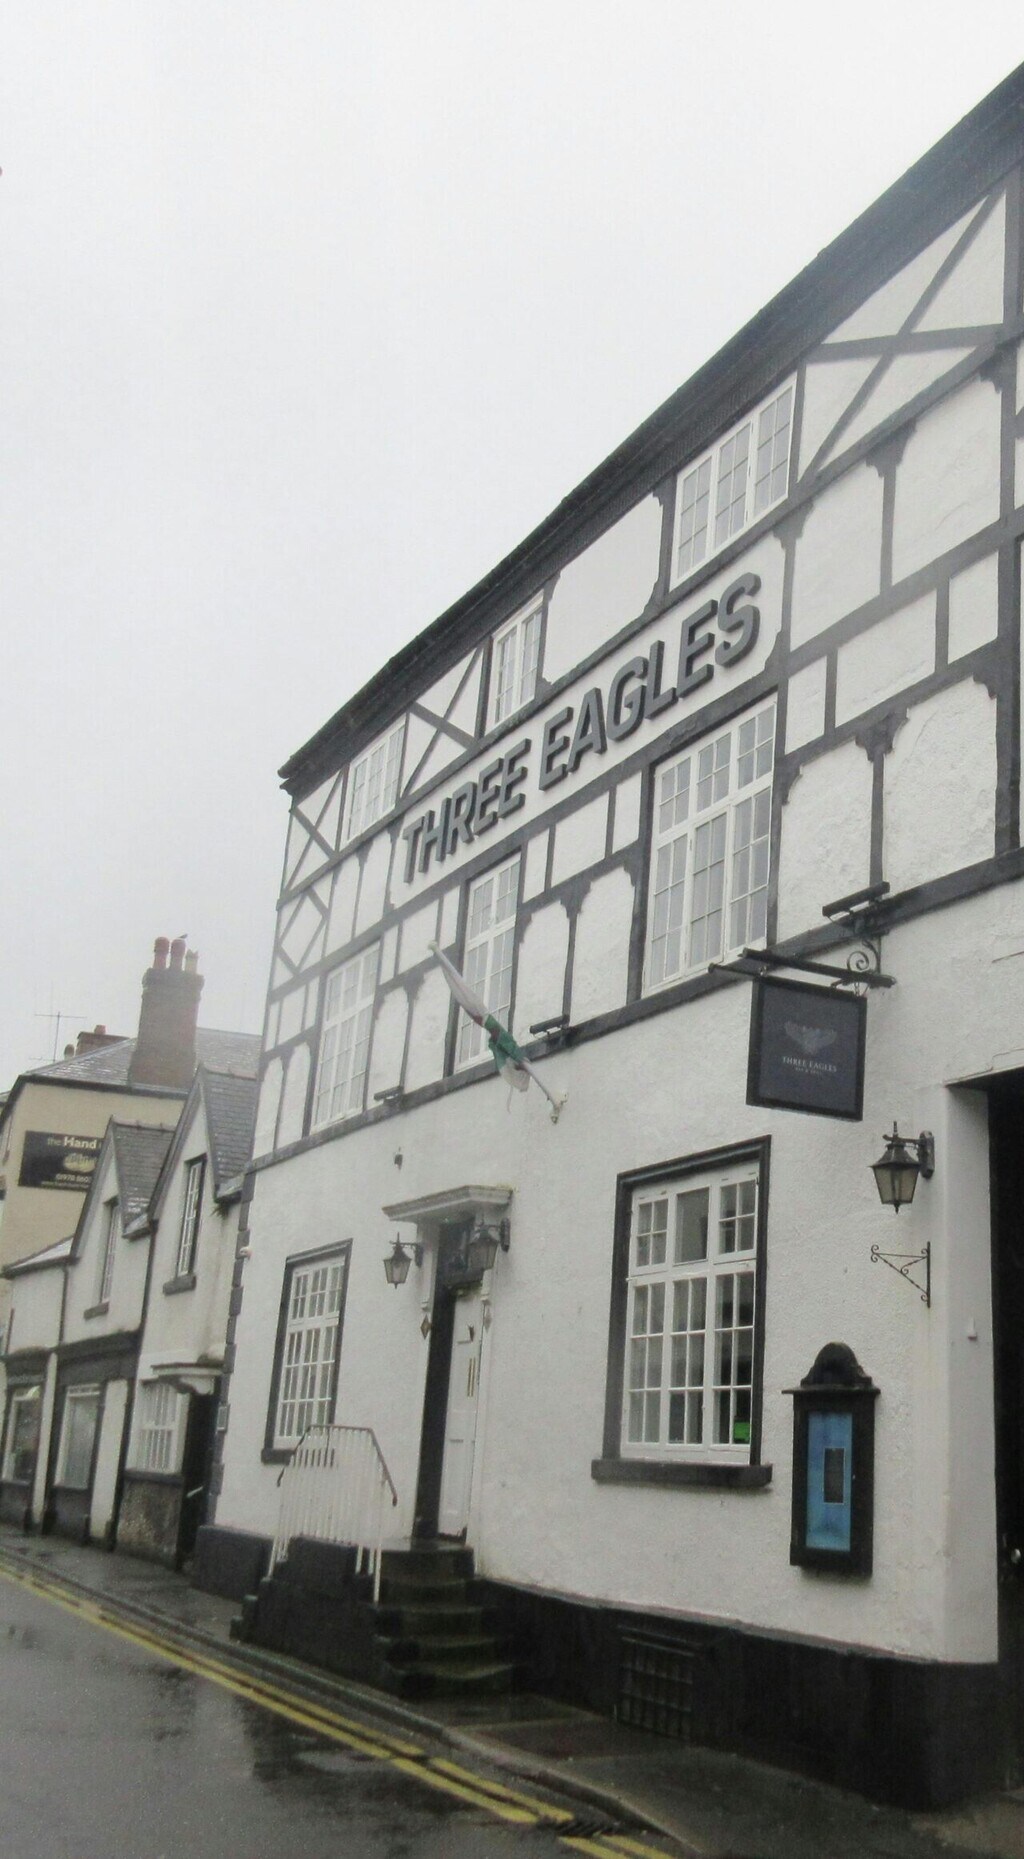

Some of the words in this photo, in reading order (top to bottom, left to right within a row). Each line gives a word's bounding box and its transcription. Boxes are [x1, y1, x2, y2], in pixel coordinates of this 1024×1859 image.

[402, 738, 531, 883] THREE
[539, 572, 762, 791] EAGLES
[783, 1056, 806, 1067] THREE
[809, 1060, 837, 1072] EAGLES
[47, 1137, 61, 1146] the
[63, 1136, 97, 1149] Hand
